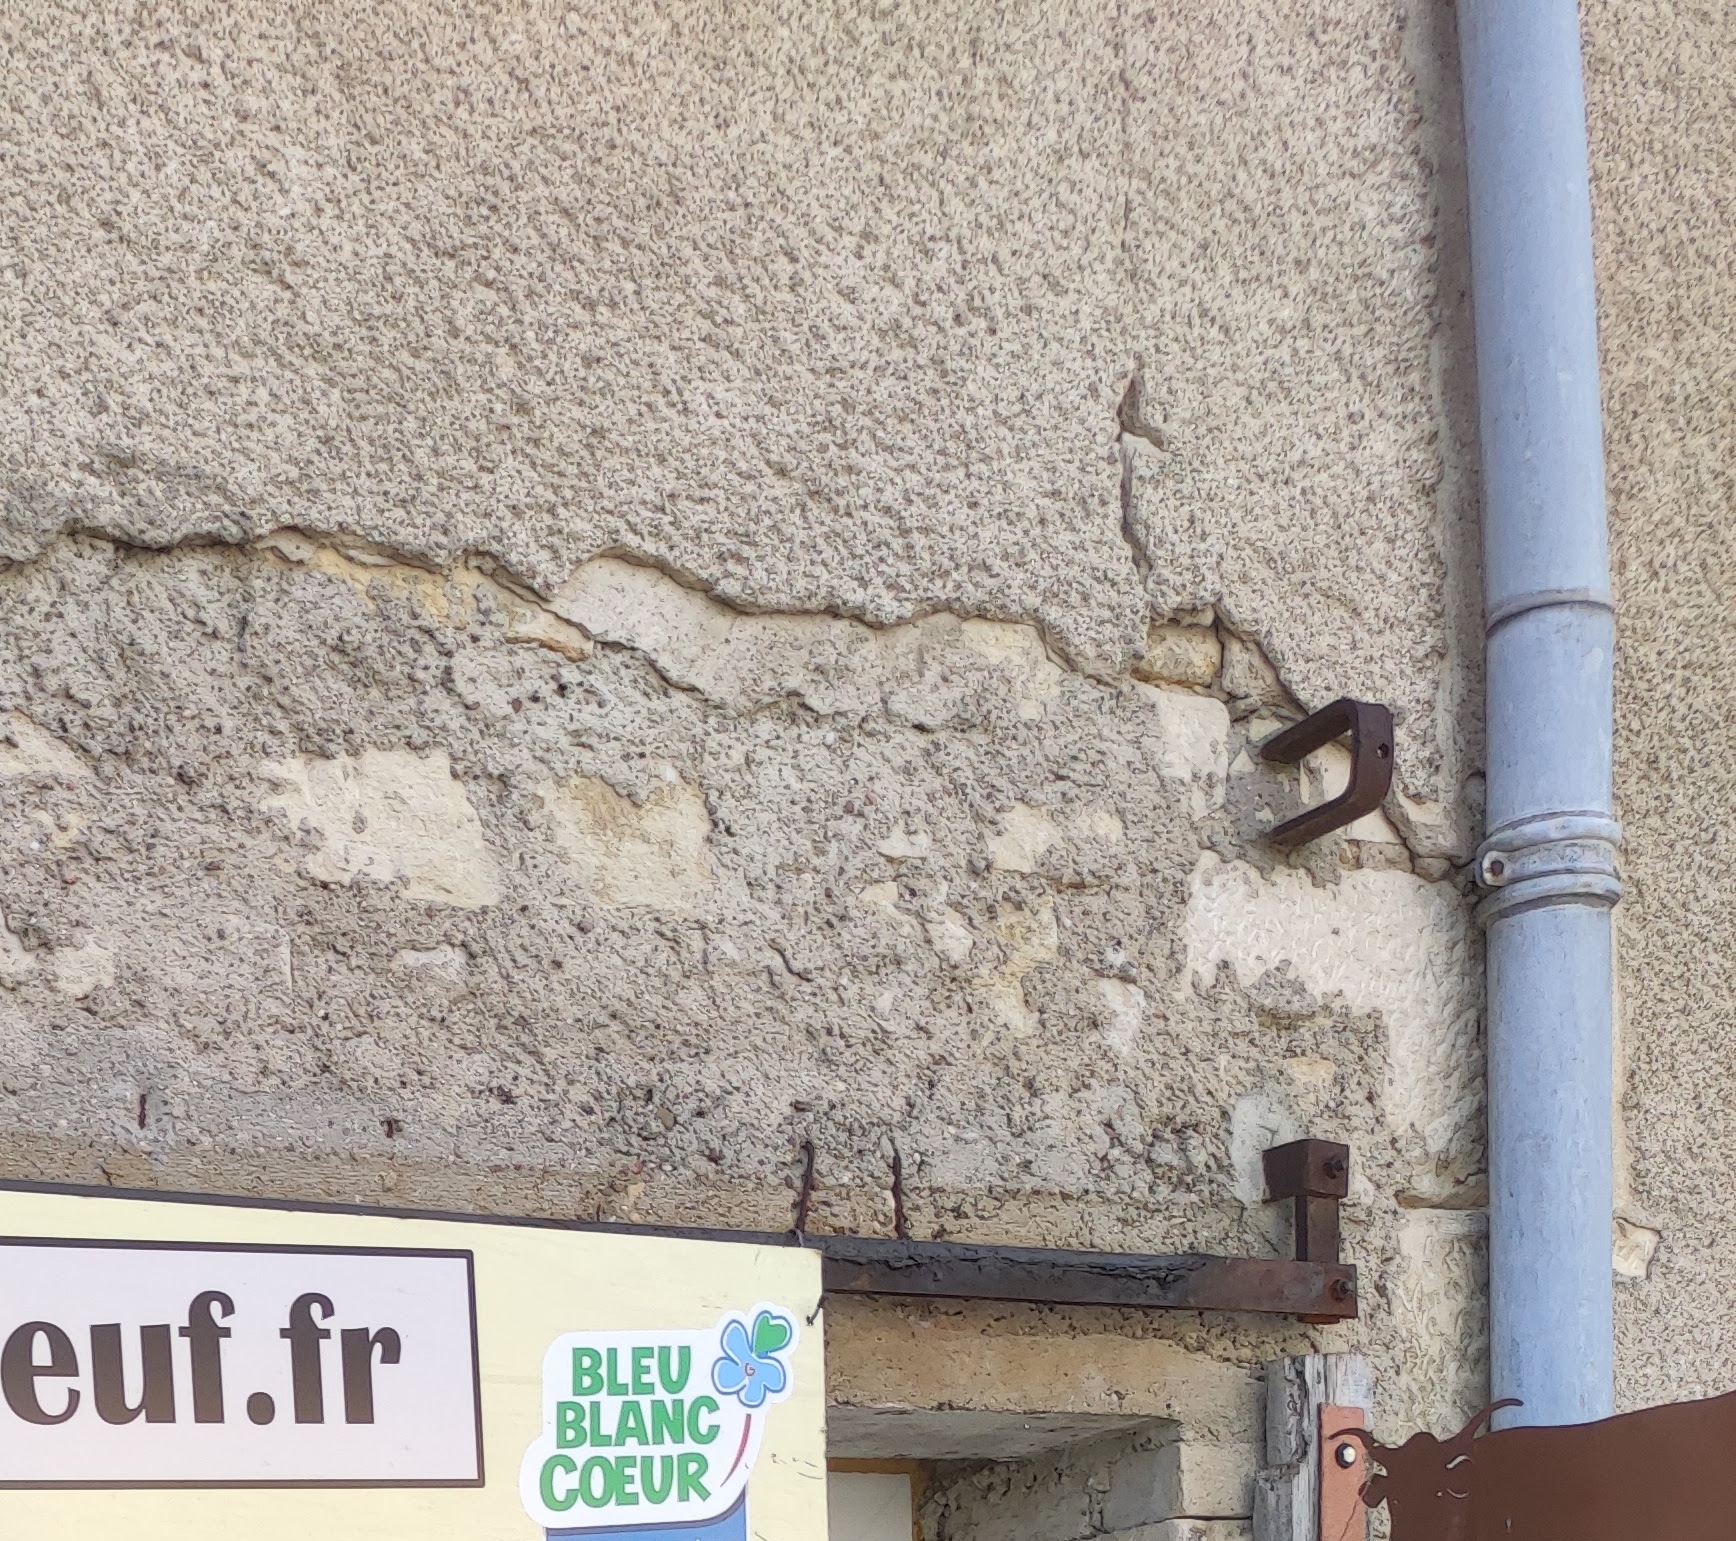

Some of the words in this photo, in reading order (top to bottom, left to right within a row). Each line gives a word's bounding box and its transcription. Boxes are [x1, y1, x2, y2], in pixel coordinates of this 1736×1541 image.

[571, 1345, 692, 1396] BLEU
[555, 1394, 721, 1449] BLANC
[539, 1452, 712, 1512] COEUR
